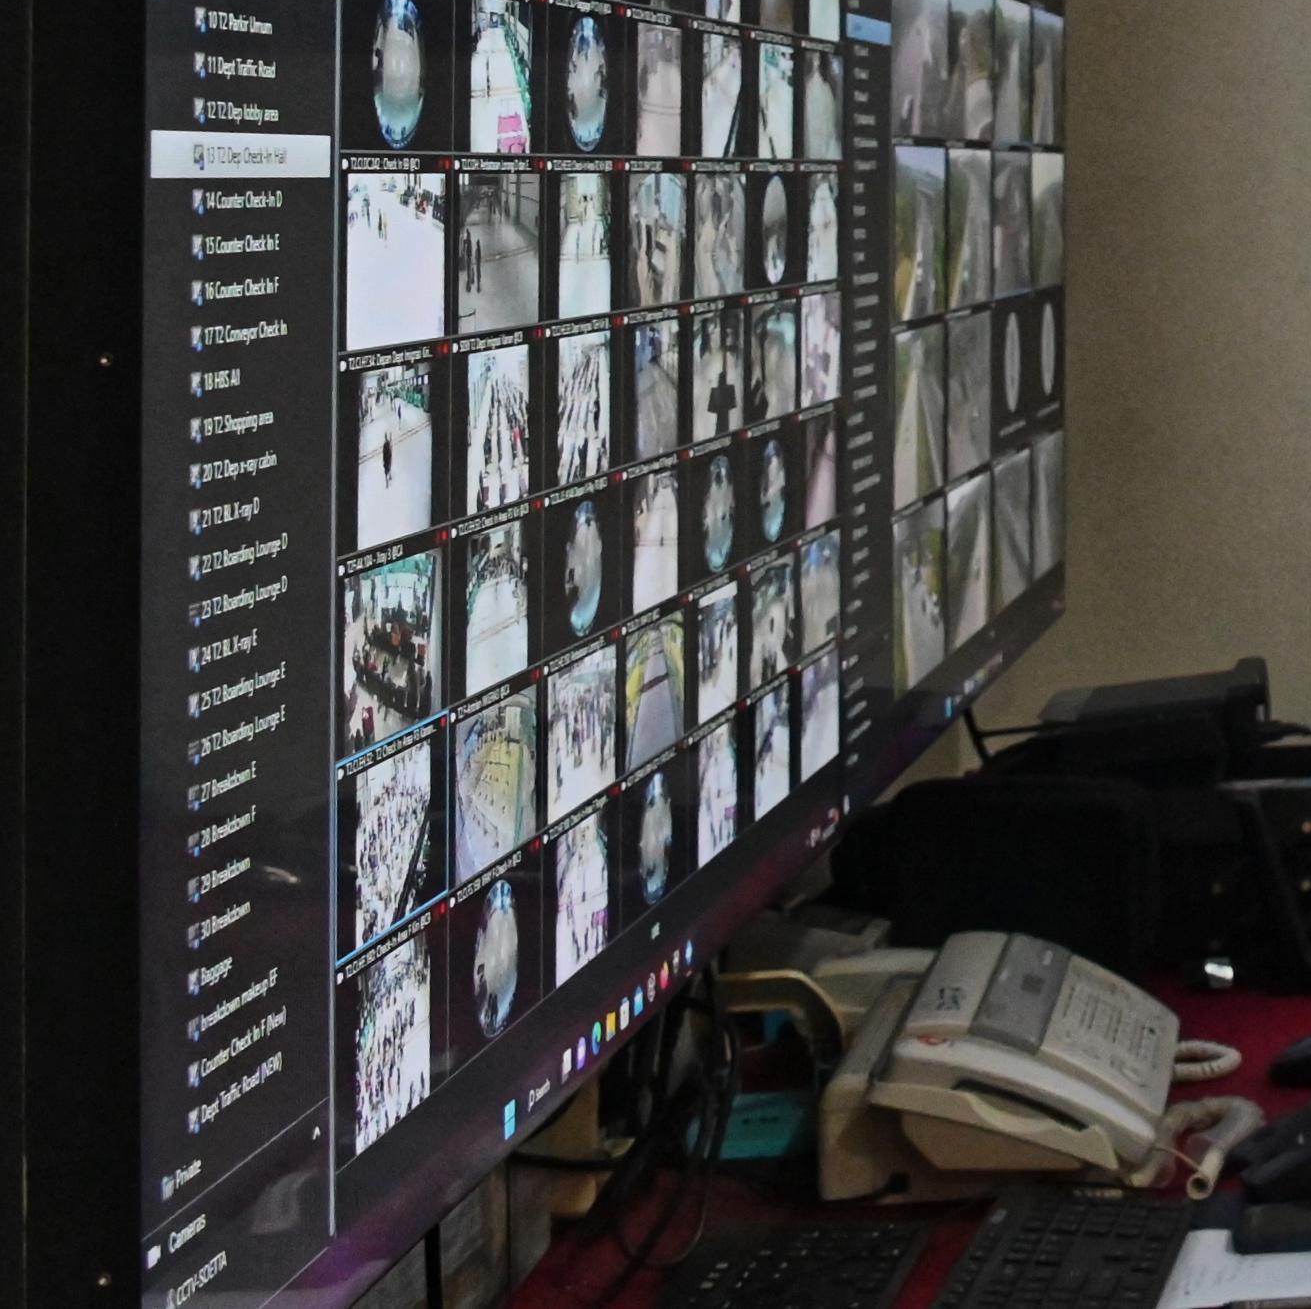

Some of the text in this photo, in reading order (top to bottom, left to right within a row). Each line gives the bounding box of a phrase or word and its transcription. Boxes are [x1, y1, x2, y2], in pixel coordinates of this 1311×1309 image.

[205, 192, 215, 210] 14
[216, 191, 244, 209] Counter
[223, 543, 255, 568] Boarding
[255, 536, 281, 558] Lounge
[222, 678, 254, 702] Boarding
[255, 668, 281, 690] Lounge
[212, 767, 250, 796] Breakdown
[201, 955, 233, 987] Baggage
[200, 1045, 230, 1078] Counter
[230, 1030, 252, 1058] Check
[267, 1004, 287, 1036] (New)
[200, 1050, 283, 1125] Dept Traffic Road (NEW)
[175, 1157, 202, 1189] Private
[168, 1213, 206, 1254] Cameras
[176, 1250, 228, 1306] CCTV-SOETTA
